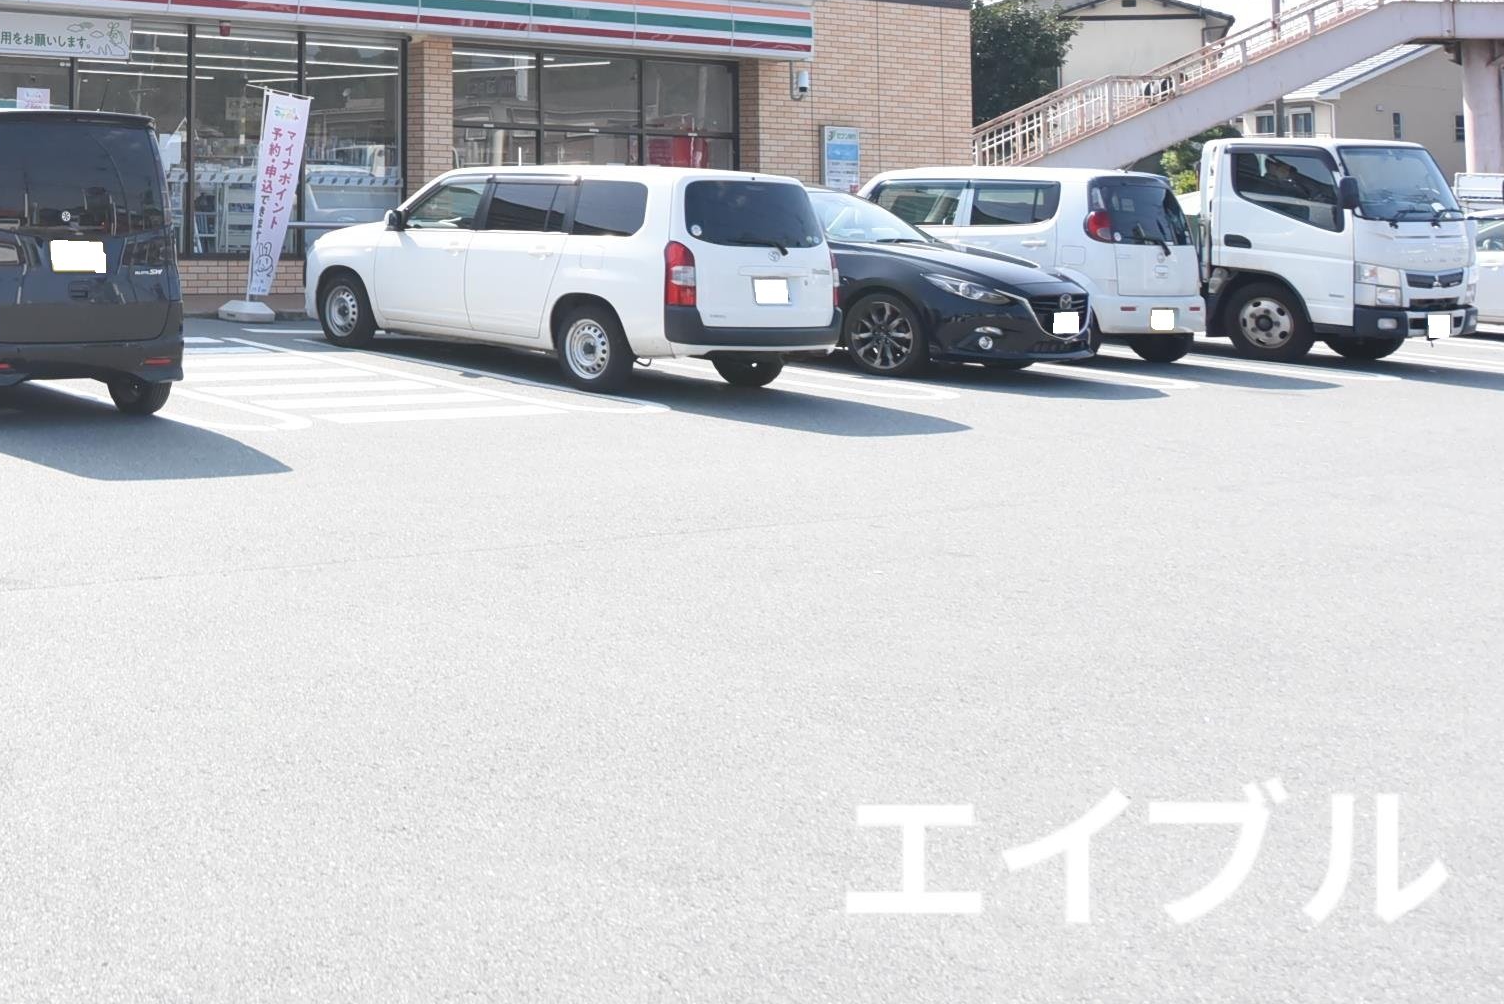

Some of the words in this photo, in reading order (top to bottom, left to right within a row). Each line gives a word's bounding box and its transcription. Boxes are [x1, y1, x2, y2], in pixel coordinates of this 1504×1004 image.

[270, 130, 297, 229] マイナポイント
